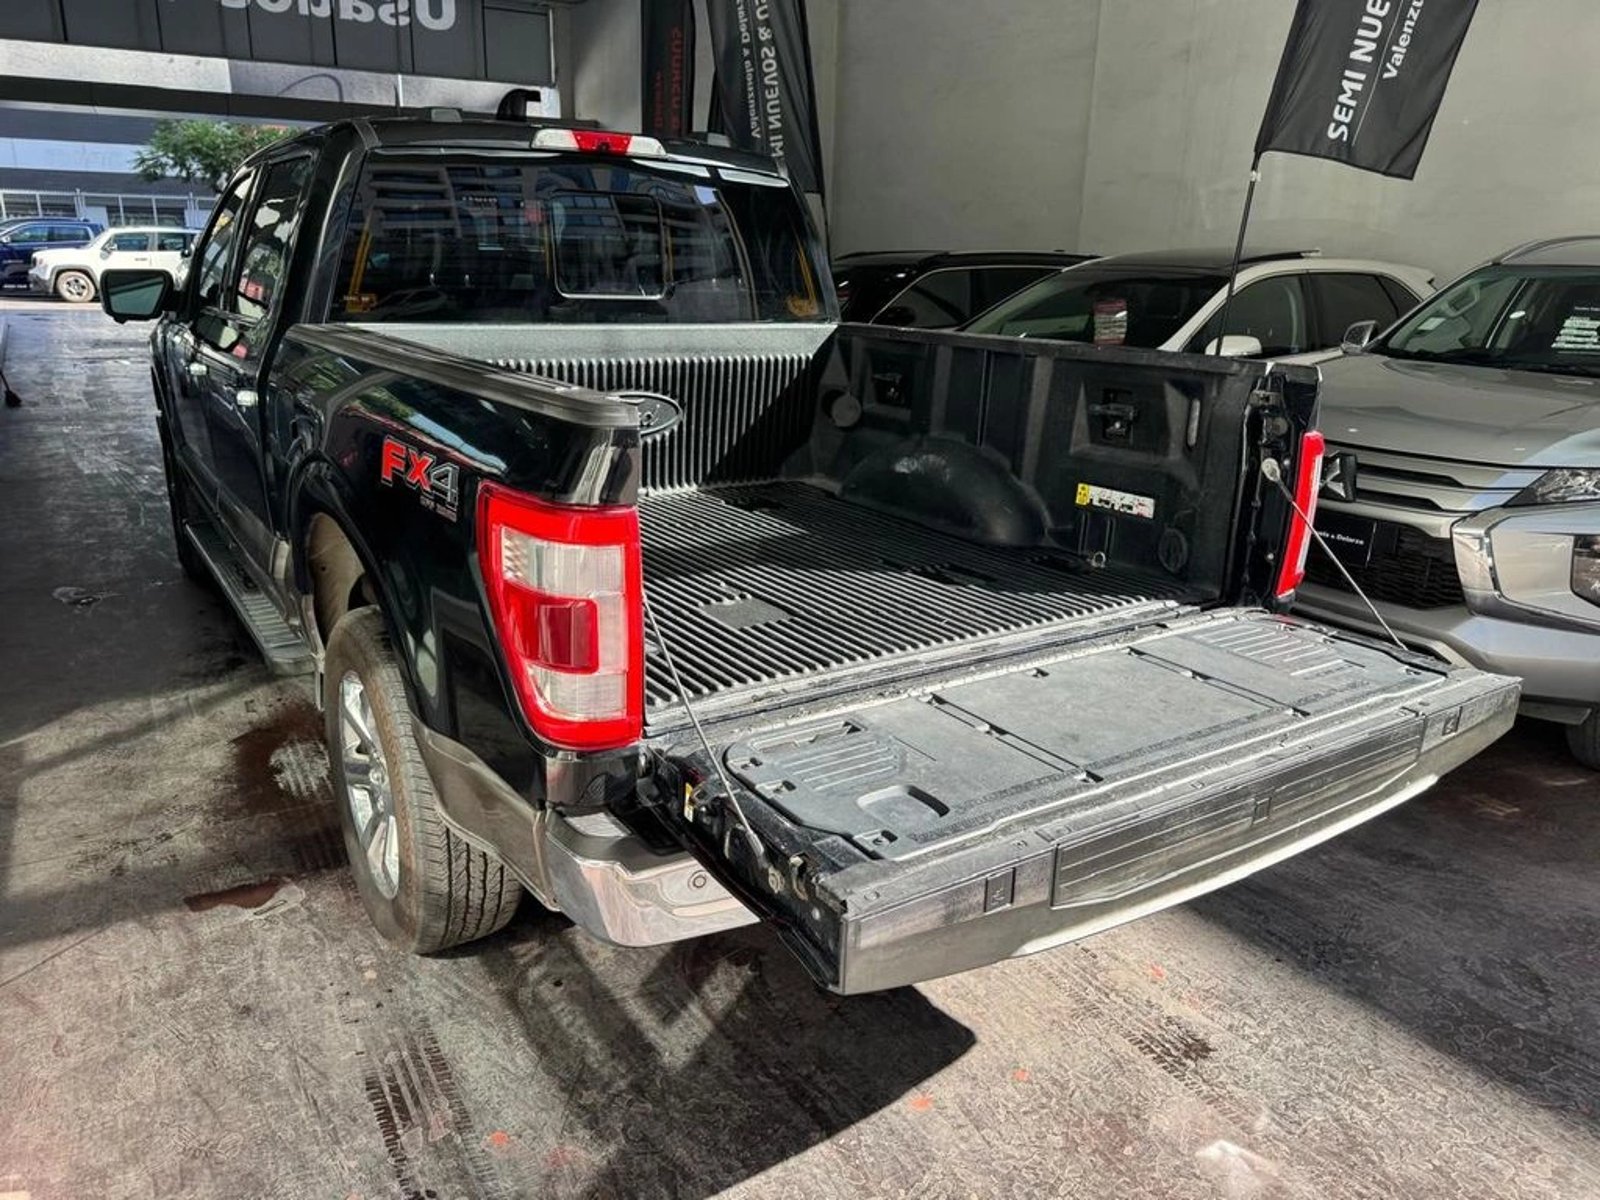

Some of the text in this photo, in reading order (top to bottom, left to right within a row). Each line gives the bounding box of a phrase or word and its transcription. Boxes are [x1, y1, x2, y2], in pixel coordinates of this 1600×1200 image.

[1327, 0, 1391, 142] SEMI NUE
[381, 434, 460, 512] FX4
